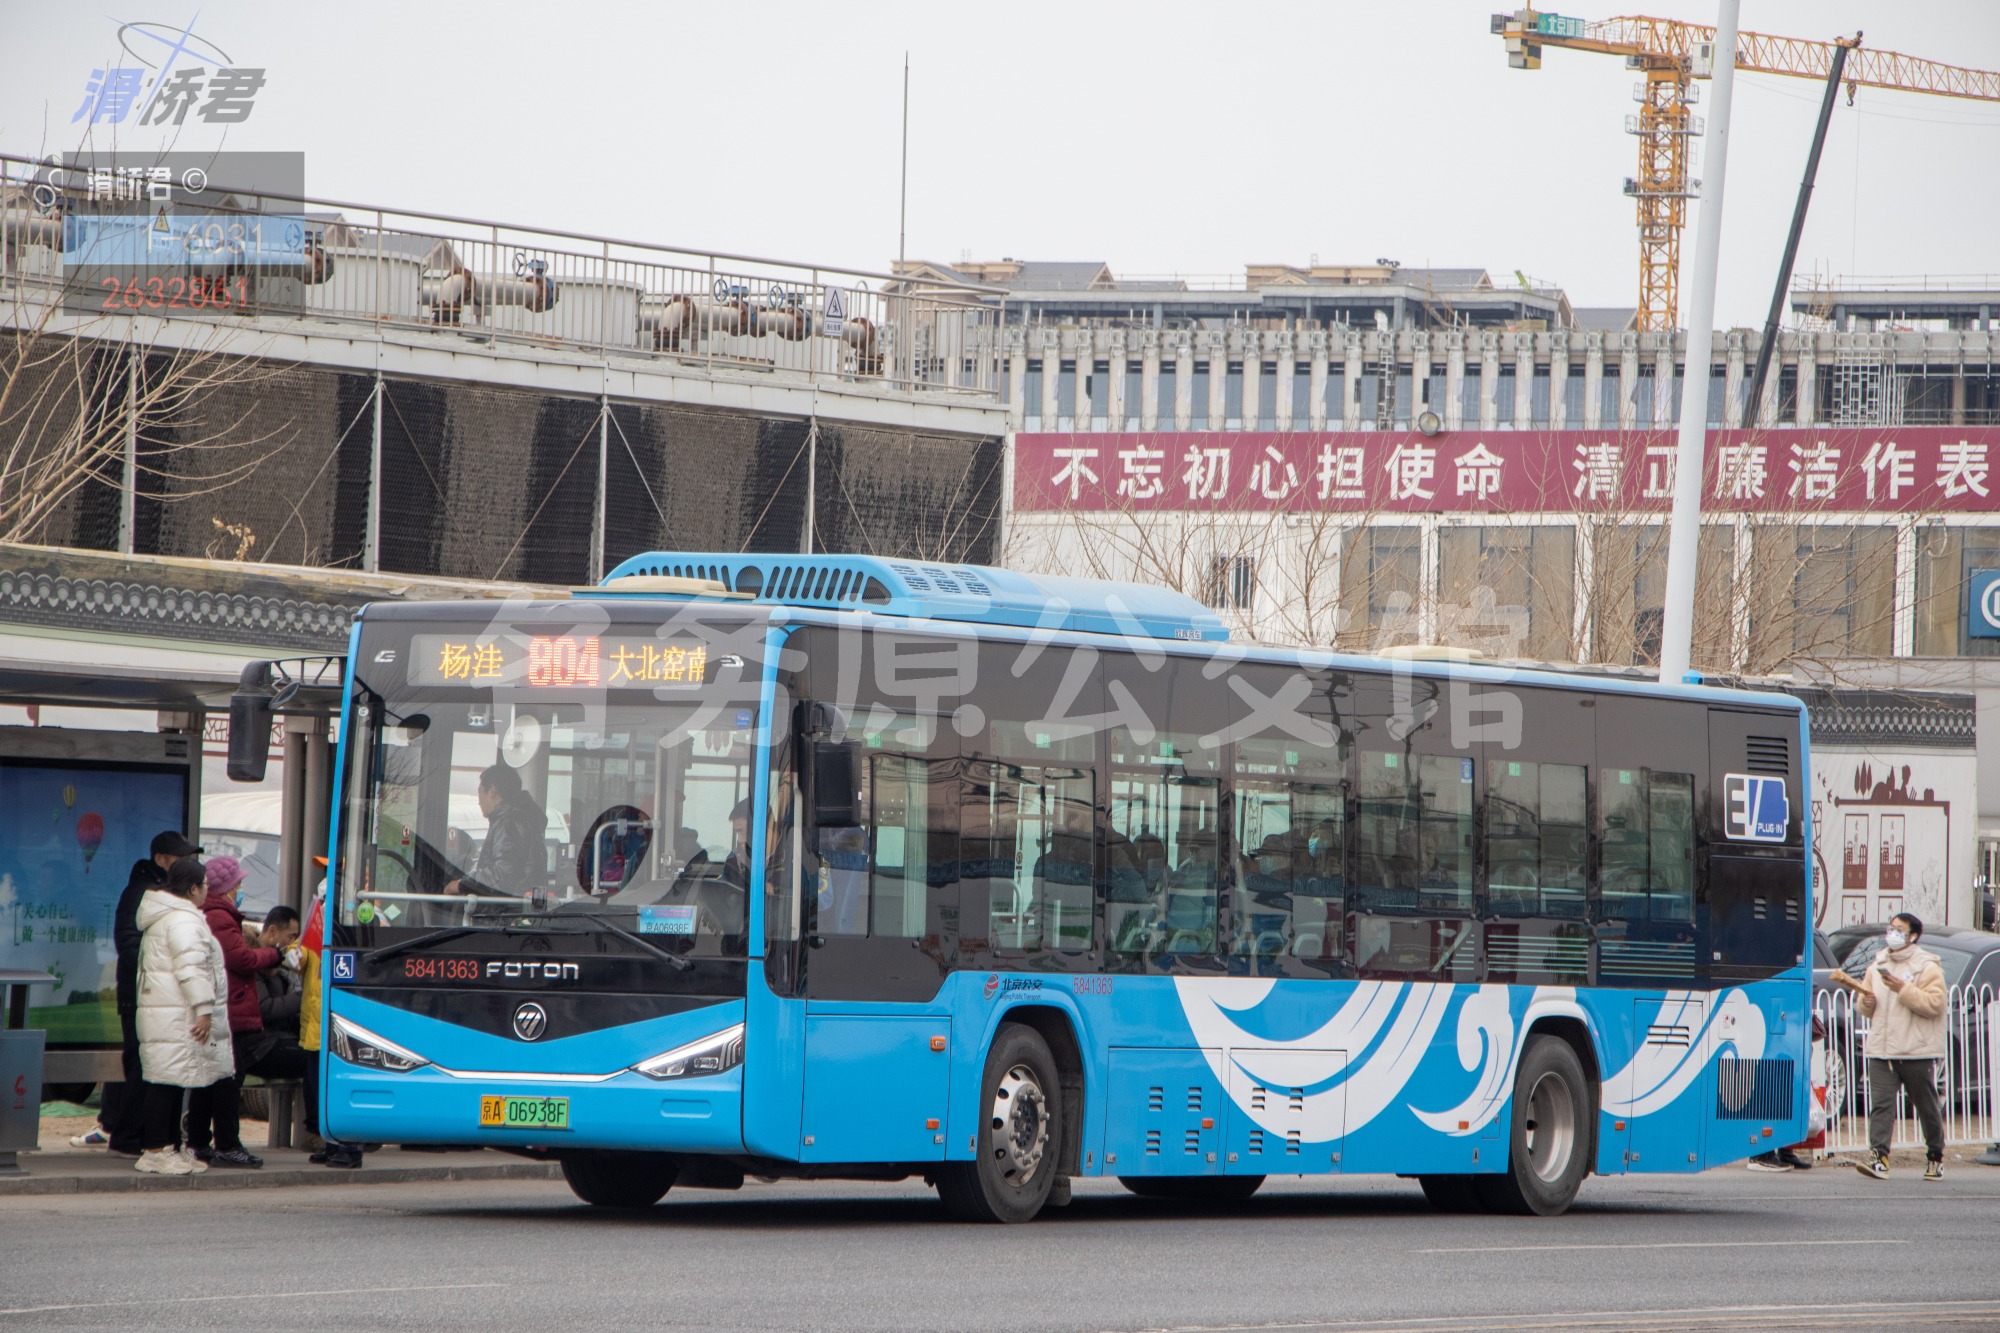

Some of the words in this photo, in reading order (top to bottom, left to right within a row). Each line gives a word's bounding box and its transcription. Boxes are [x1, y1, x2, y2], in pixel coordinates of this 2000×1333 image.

[1051, 443, 1505, 501] 不忘初心担使命
[438, 642, 504, 681] 杨洼
[528, 636, 601, 687] 804
[405, 958, 479, 980] 5841363
[486, 961, 580, 980] FOTON
[1001, 978, 1043, 991] 北京公交
[1073, 977, 1113, 995] 5841363
